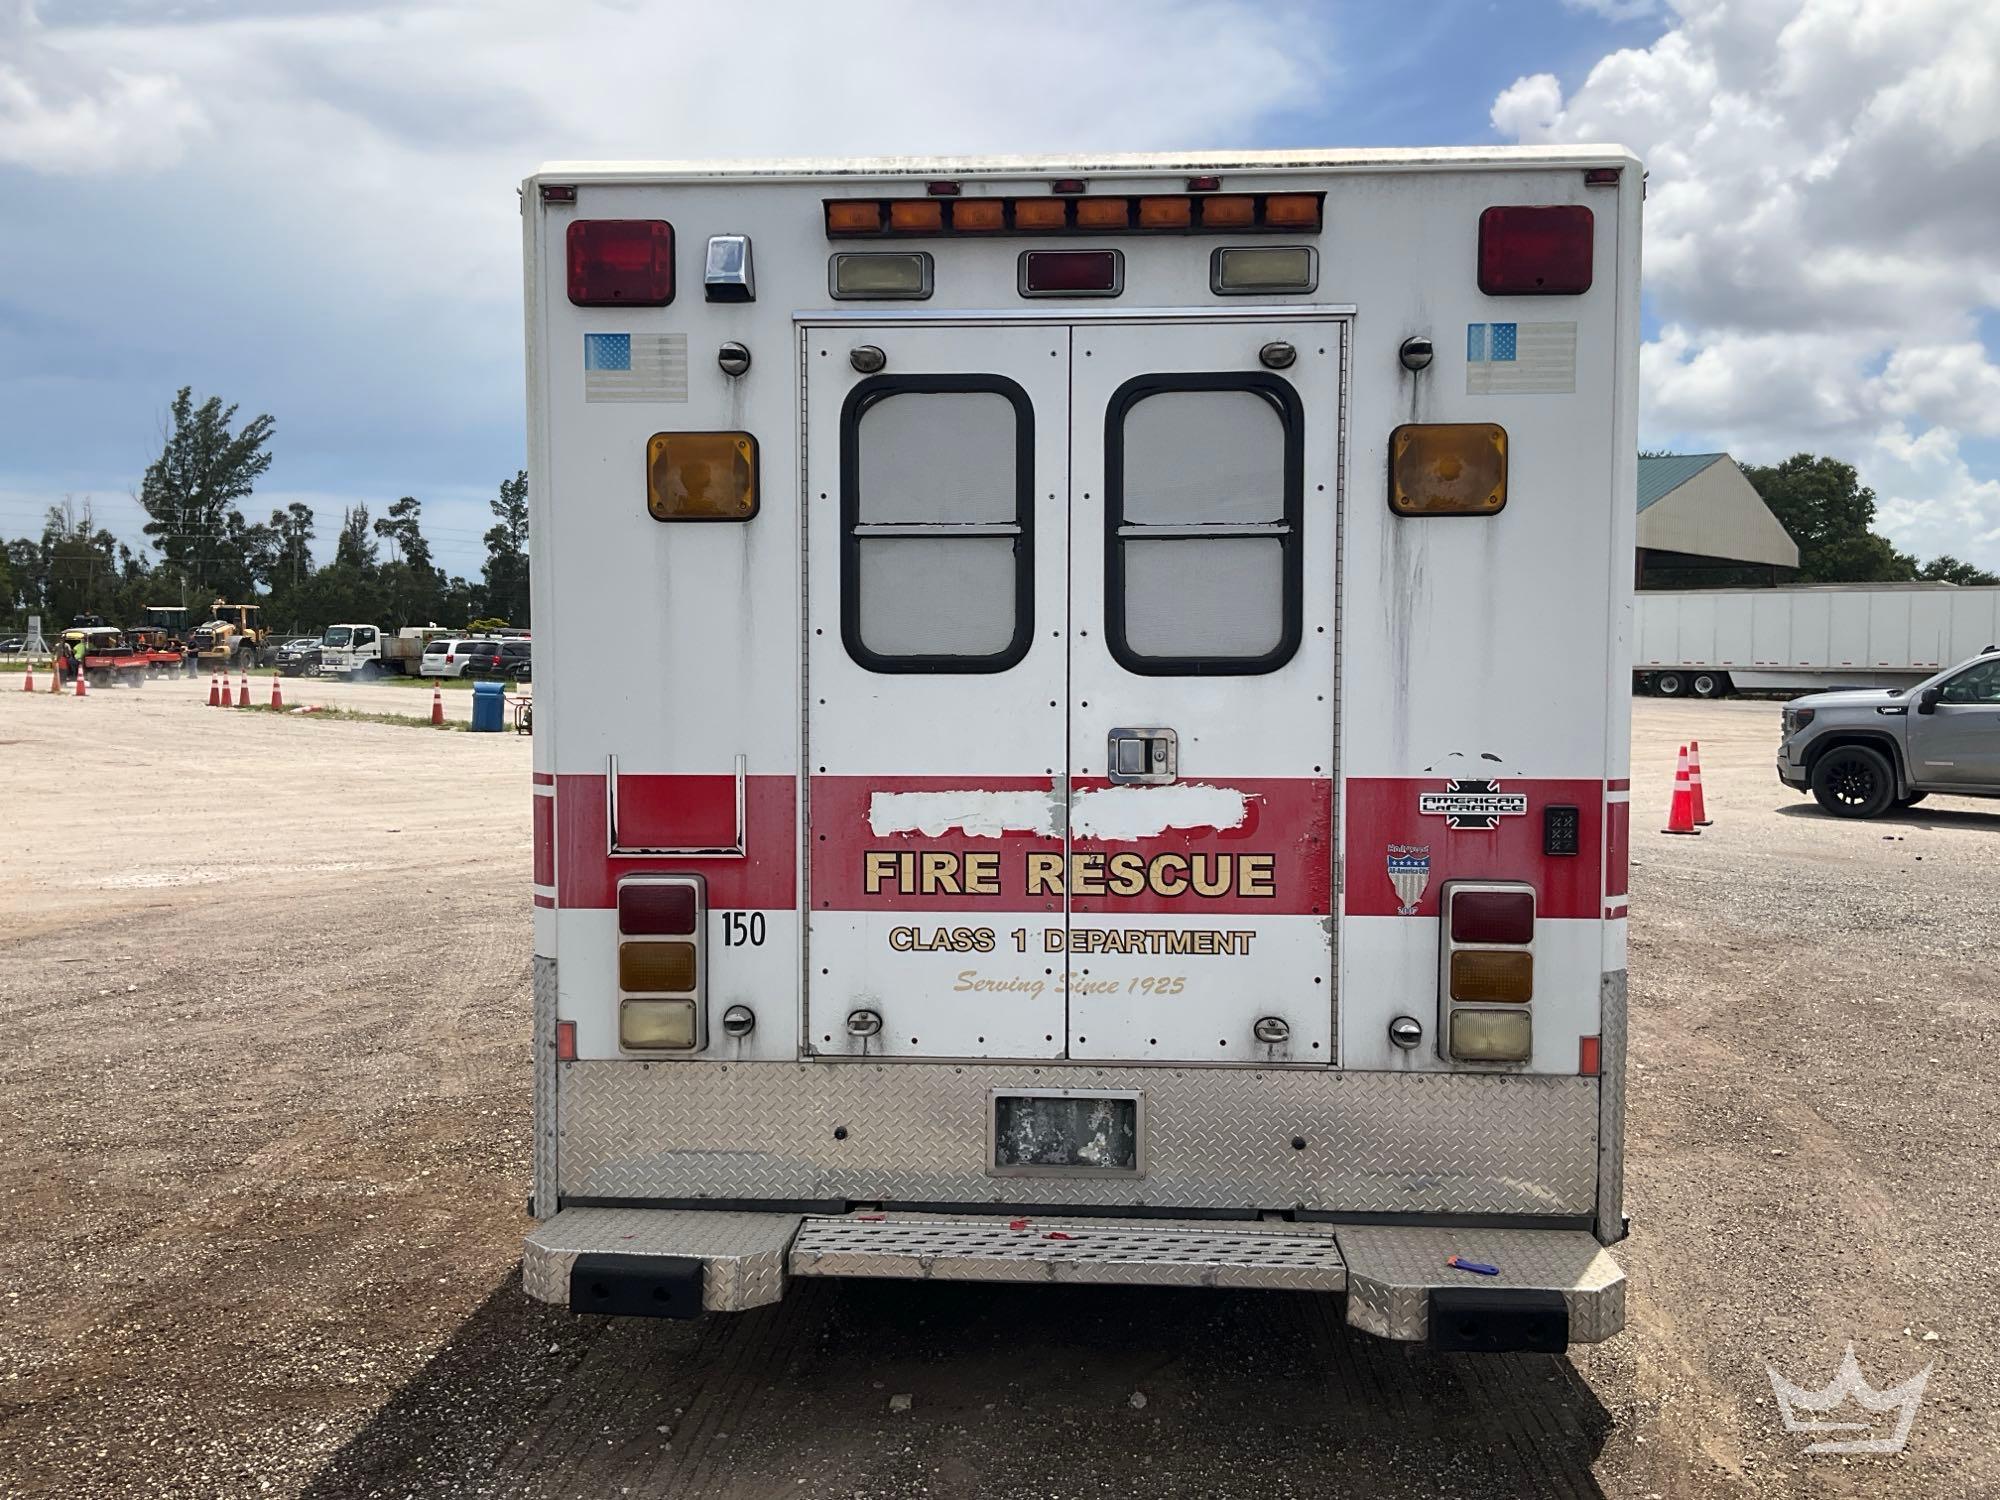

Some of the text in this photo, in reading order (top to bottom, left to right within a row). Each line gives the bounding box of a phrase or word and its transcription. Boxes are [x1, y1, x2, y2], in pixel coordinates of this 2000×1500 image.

[864, 850, 1277, 898] FIRE RESCUE
[721, 911, 766, 947] 150
[889, 926, 1256, 955] CLASS 1 DEPARTMENT
[953, 970, 1188, 1000] Serving Since 1925
